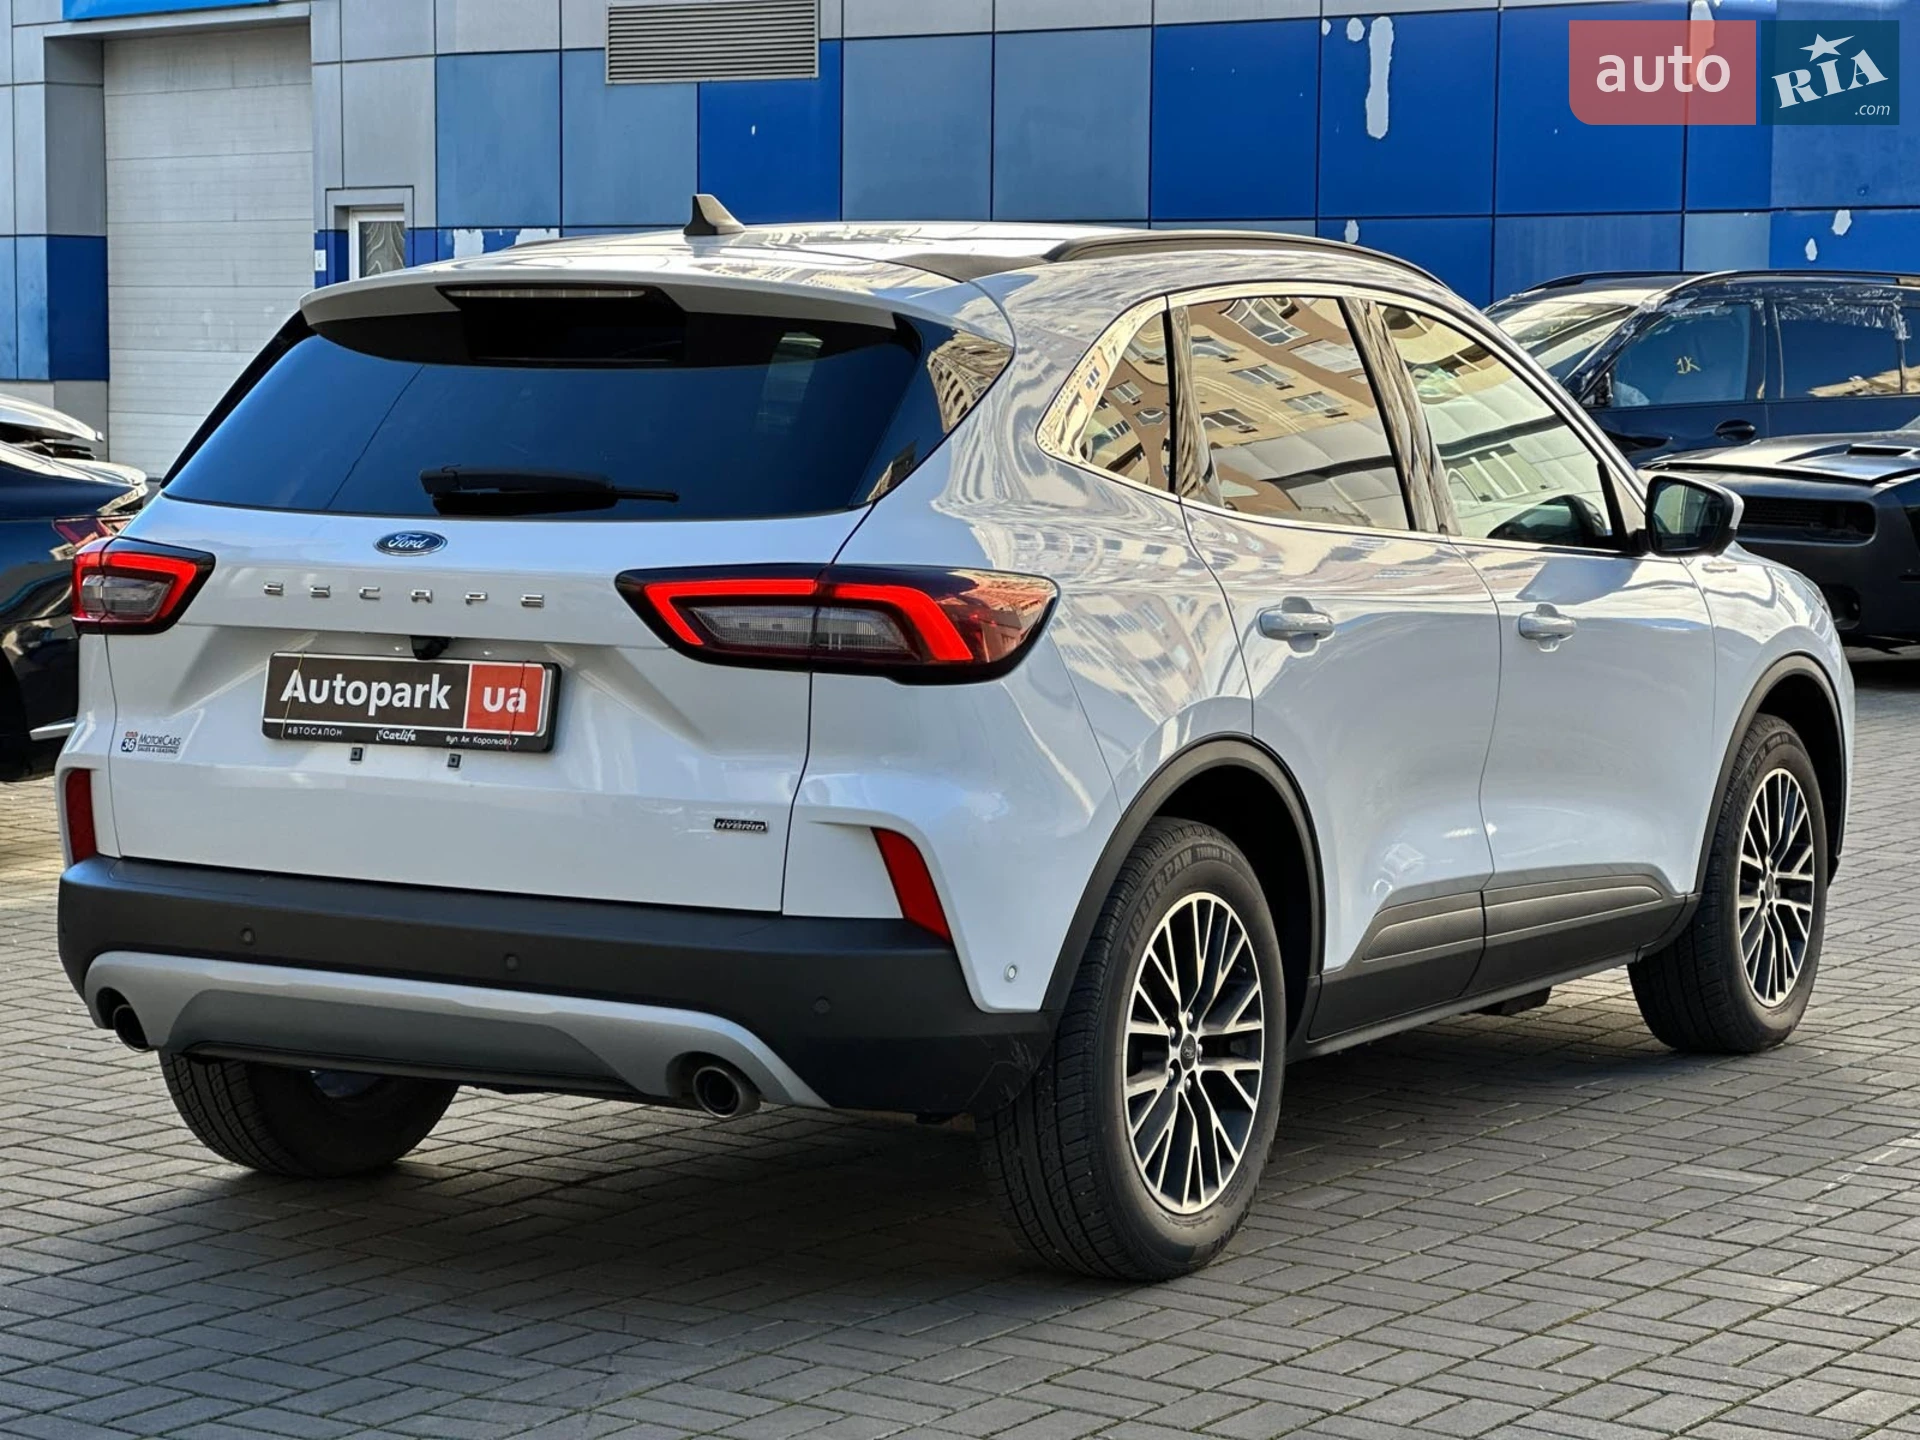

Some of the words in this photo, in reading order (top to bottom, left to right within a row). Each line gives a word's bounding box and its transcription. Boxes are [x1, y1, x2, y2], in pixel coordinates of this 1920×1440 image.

[387, 533, 430, 550] Ford
[263, 581, 545, 609] ESCAPE
[279, 669, 452, 717] Autopark
[482, 685, 527, 714] ua
[121, 738, 136, 751] 36
[715, 821, 765, 831] HYBRID
[1163, 847, 1194, 884] PAW
